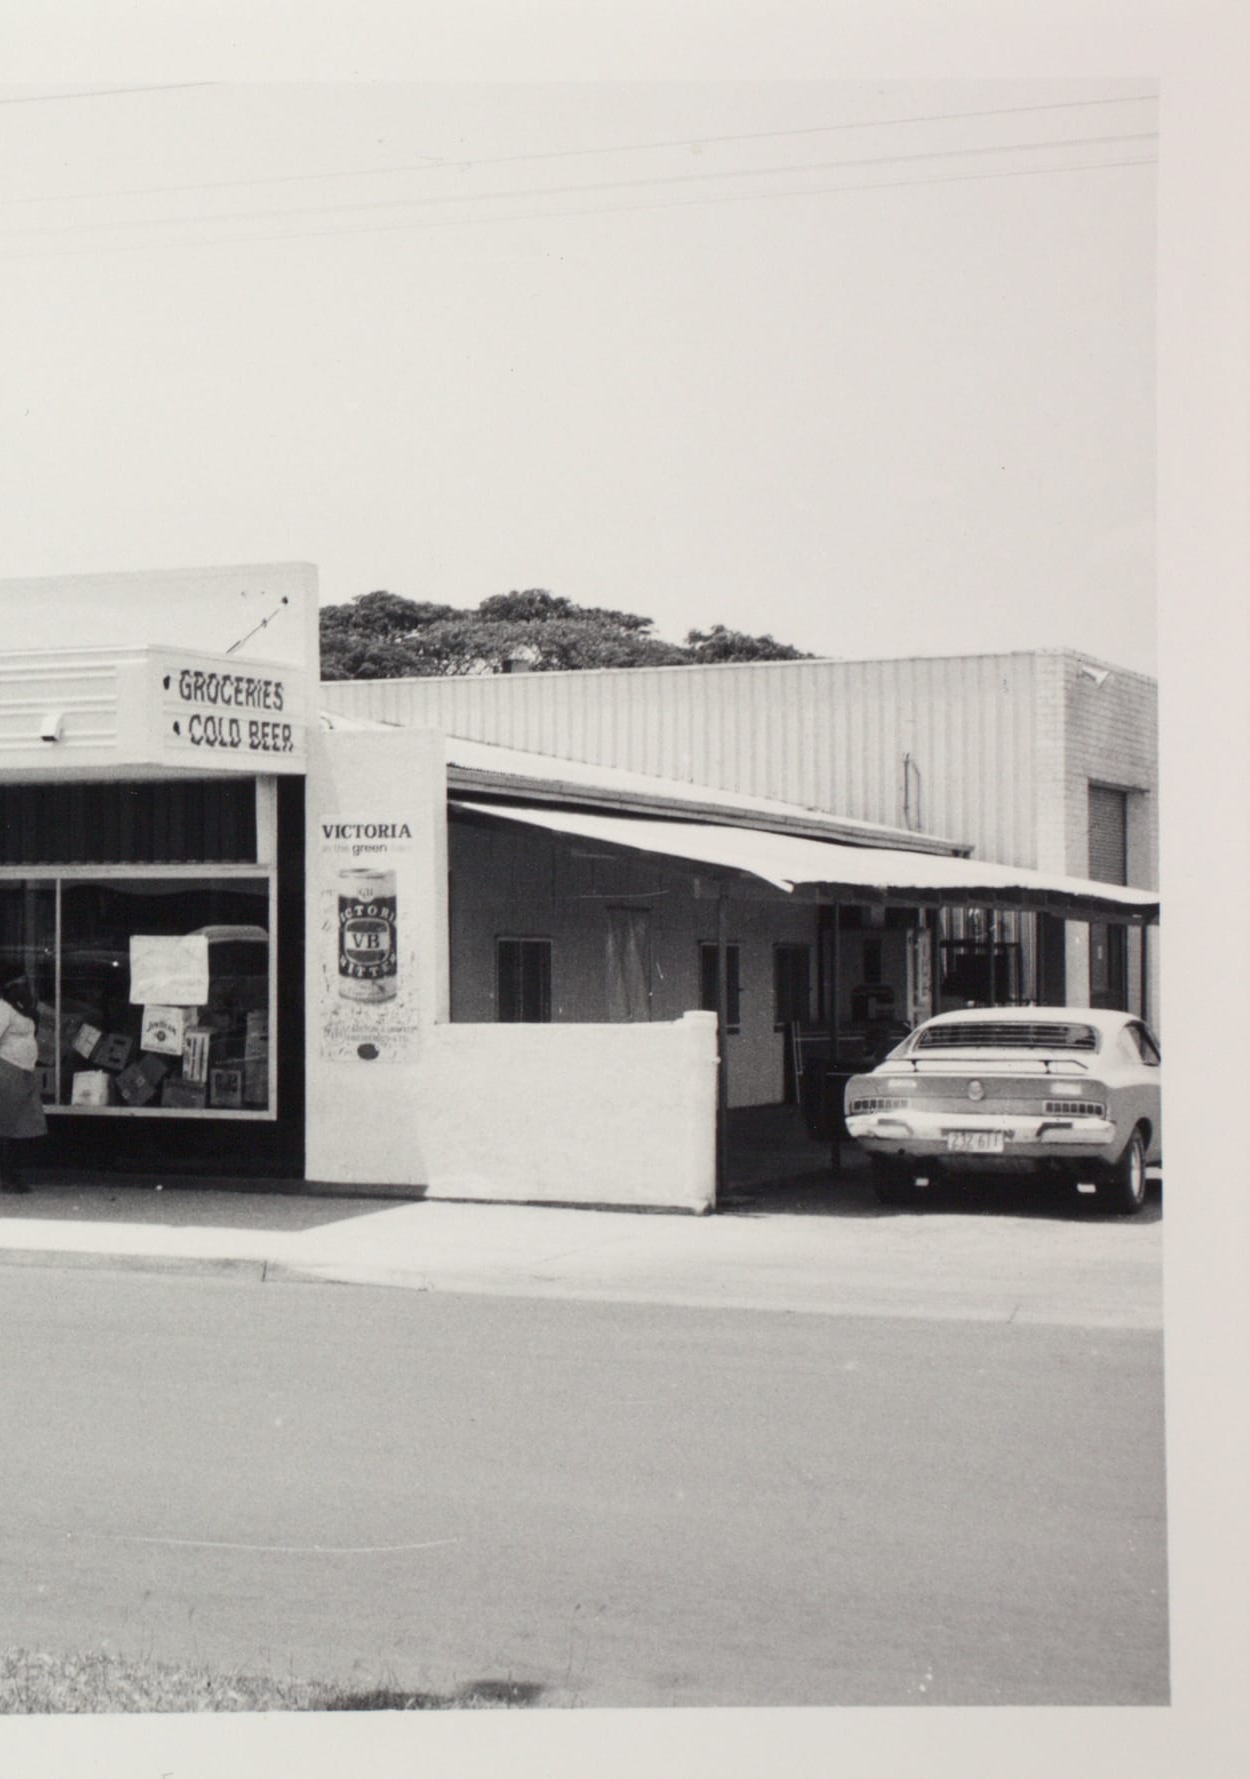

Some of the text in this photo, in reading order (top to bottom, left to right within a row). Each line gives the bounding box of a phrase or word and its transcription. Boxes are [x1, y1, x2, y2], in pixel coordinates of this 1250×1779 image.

[179, 669, 285, 712] GROCERIES
[188, 714, 294, 753] COLD BEER
[322, 823, 412, 839] VICTORIA
[352, 844, 388, 857] green
[351, 932, 381, 949] VB
